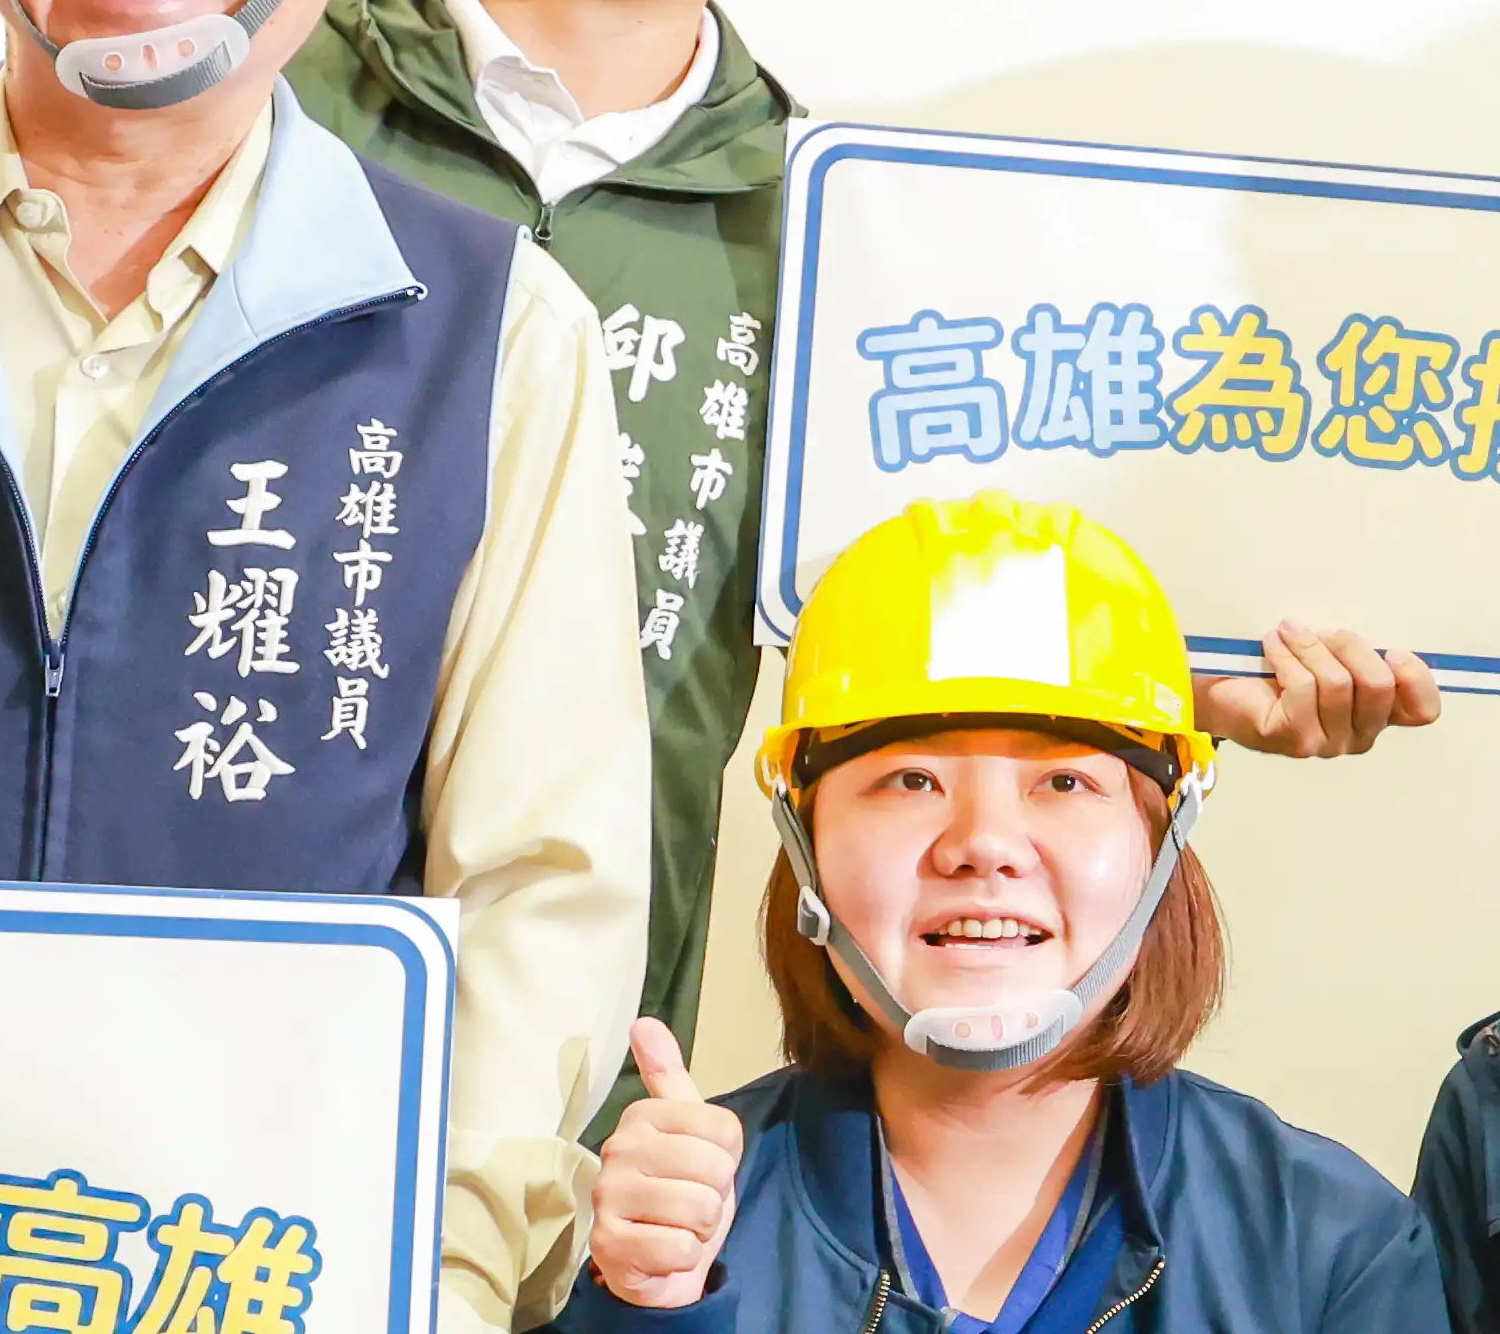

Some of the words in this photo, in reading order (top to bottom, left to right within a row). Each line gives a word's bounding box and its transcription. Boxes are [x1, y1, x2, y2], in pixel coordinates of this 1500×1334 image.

[172, 460, 300, 803] 王耀裕
[320, 417, 404, 749] 高雄市議員
[640, 311, 762, 661] 高雄市議員
